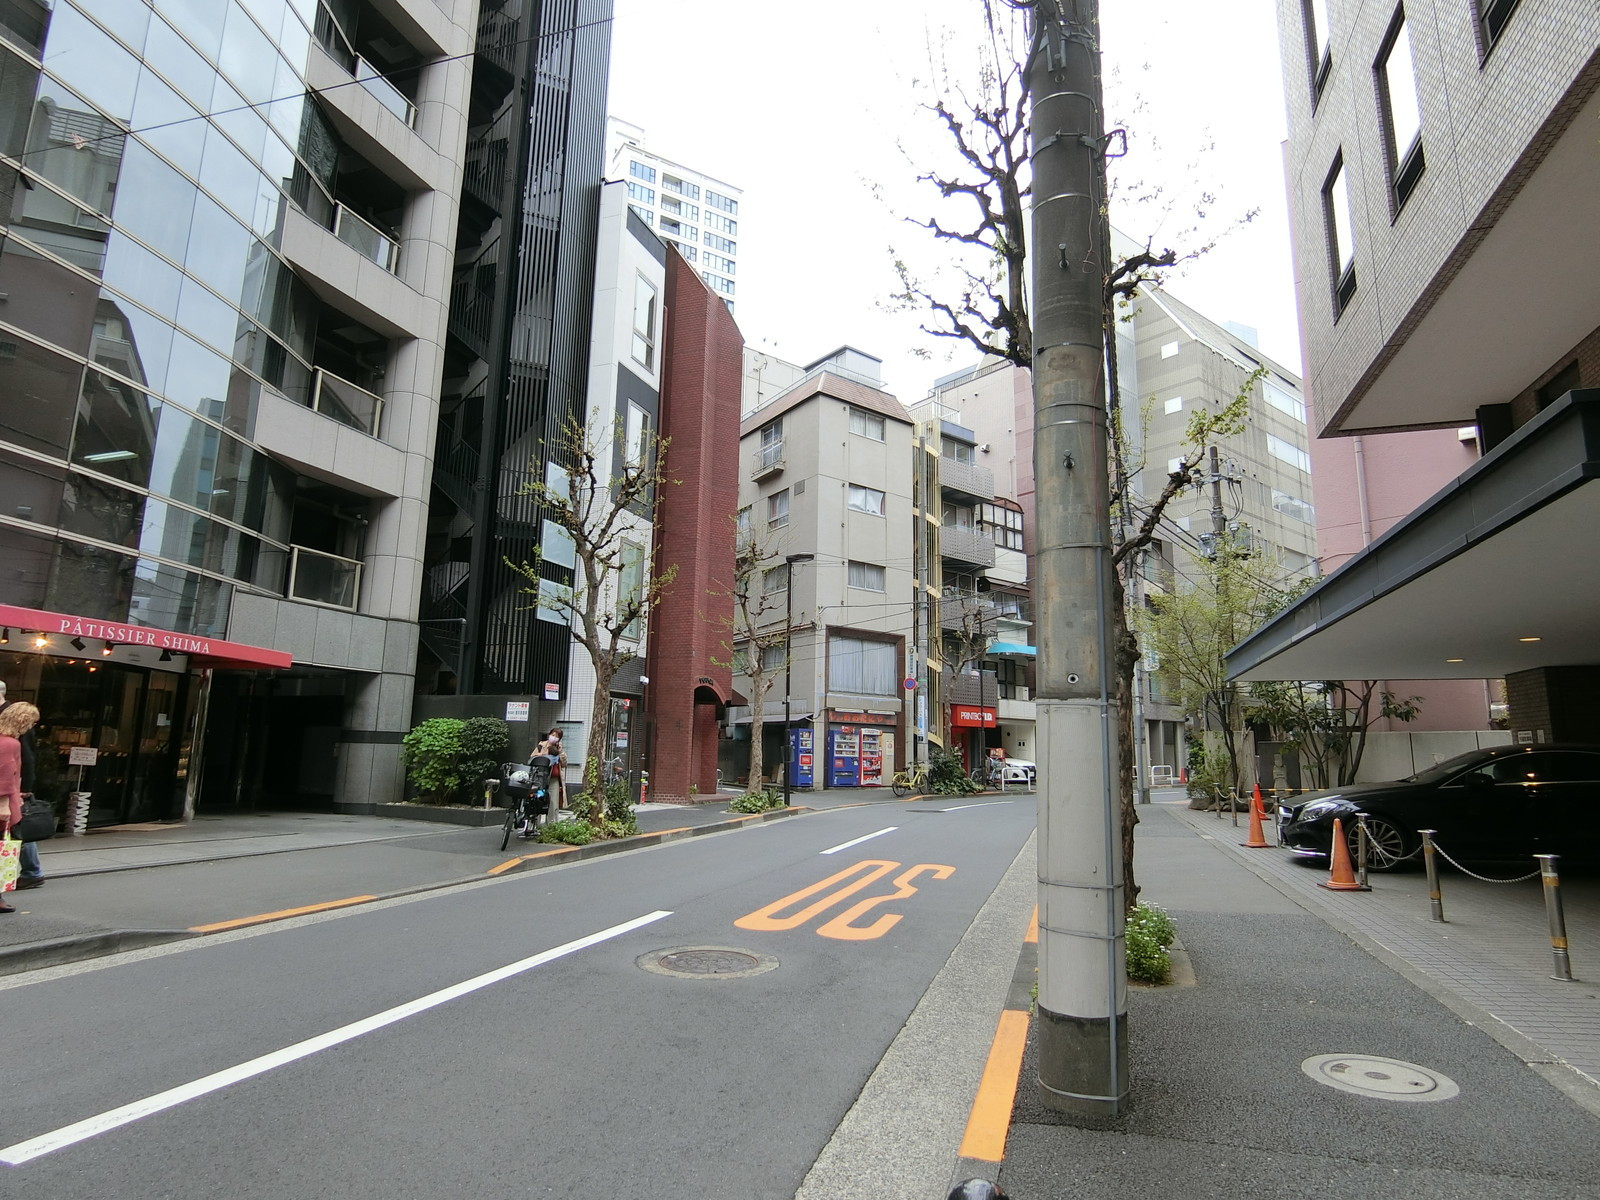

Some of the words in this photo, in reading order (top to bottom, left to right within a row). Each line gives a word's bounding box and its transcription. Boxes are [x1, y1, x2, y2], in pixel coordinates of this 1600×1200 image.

[59, 618, 156, 645] PÂTISSIER
[163, 636, 210, 653] SHIMA
[733, 859, 957, 940] 30
